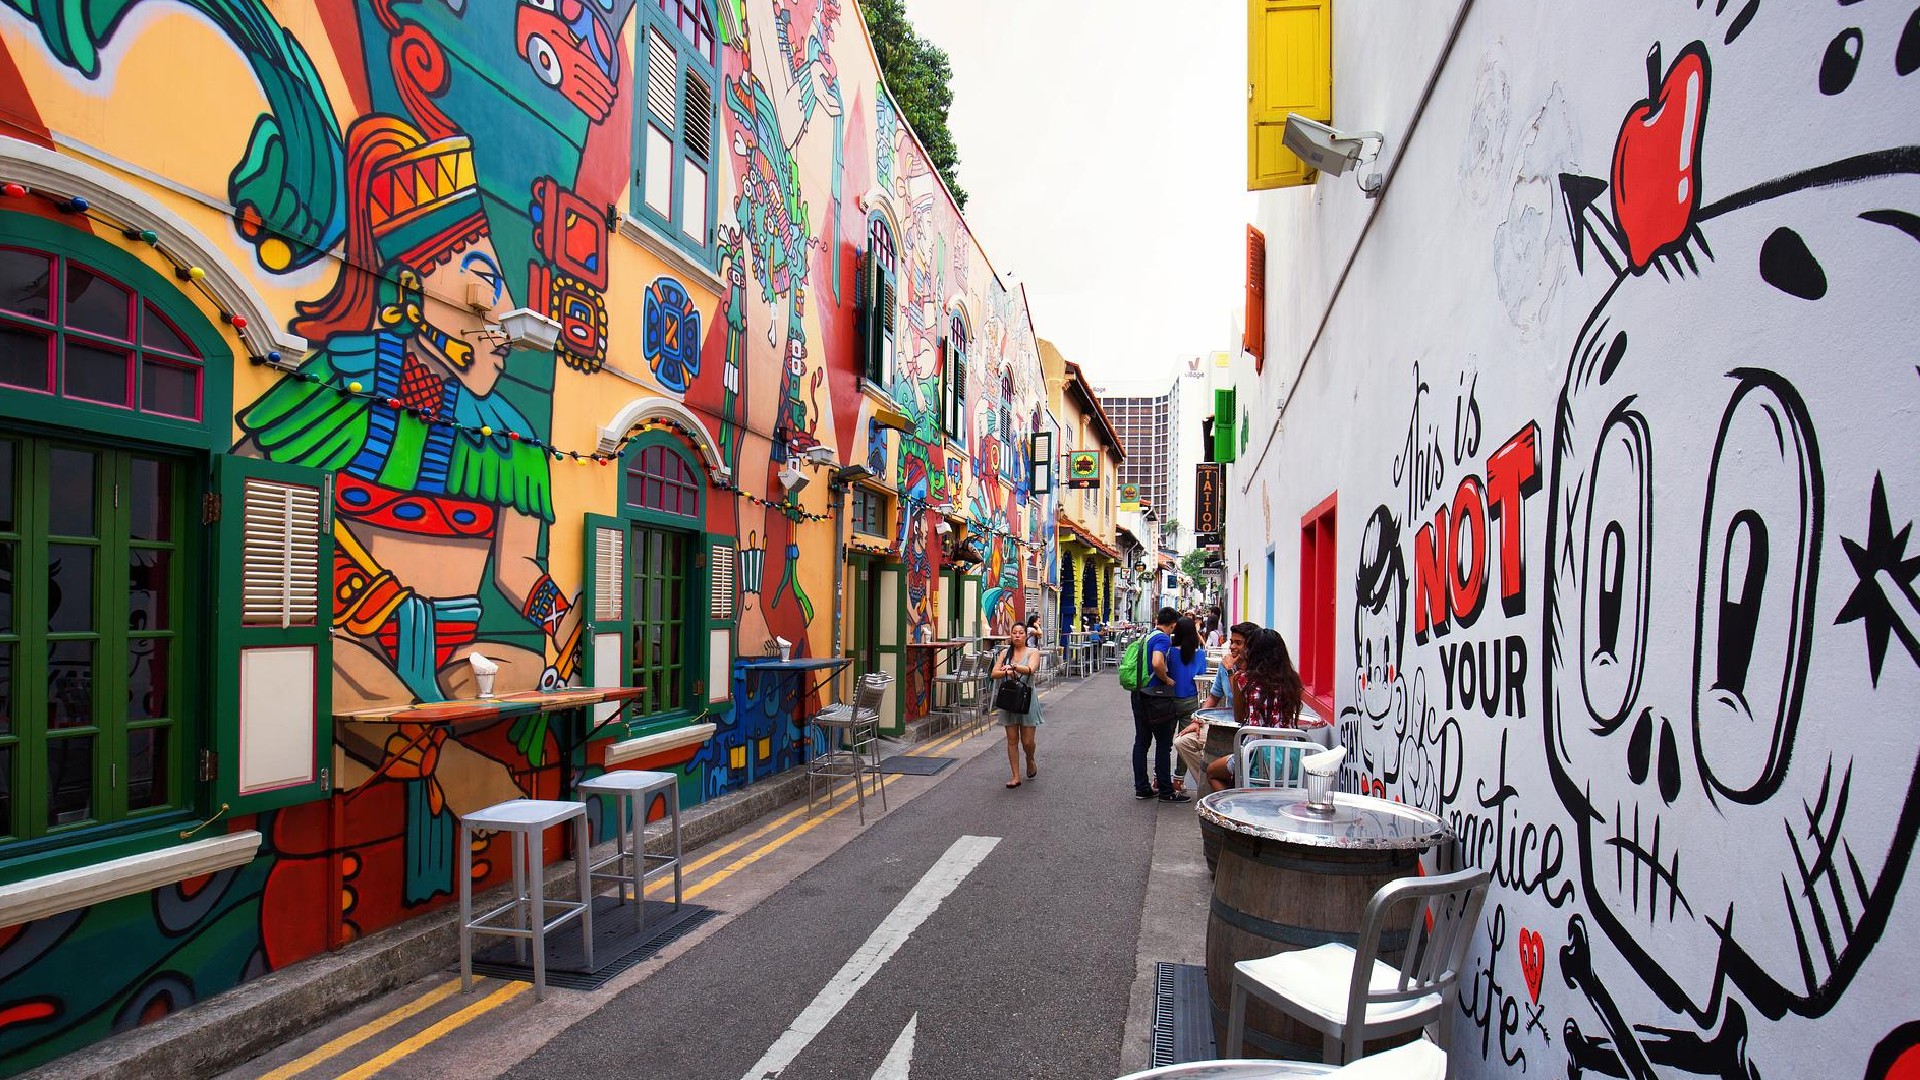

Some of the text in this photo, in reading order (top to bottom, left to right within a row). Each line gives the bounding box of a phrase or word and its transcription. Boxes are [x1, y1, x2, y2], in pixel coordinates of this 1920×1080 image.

[1184, 371, 1205, 380] village
[1454, 370, 1482, 467] is
[1202, 470, 1213, 532] TATTOO
[1414, 419, 1543, 646] NOT
[1439, 635, 1527, 719] YOUR
[1339, 762, 1359, 795] GOLD
[1340, 720, 1359, 765] STAY
[1428, 706, 1575, 909] Practice
[1458, 903, 1527, 1074] ife
